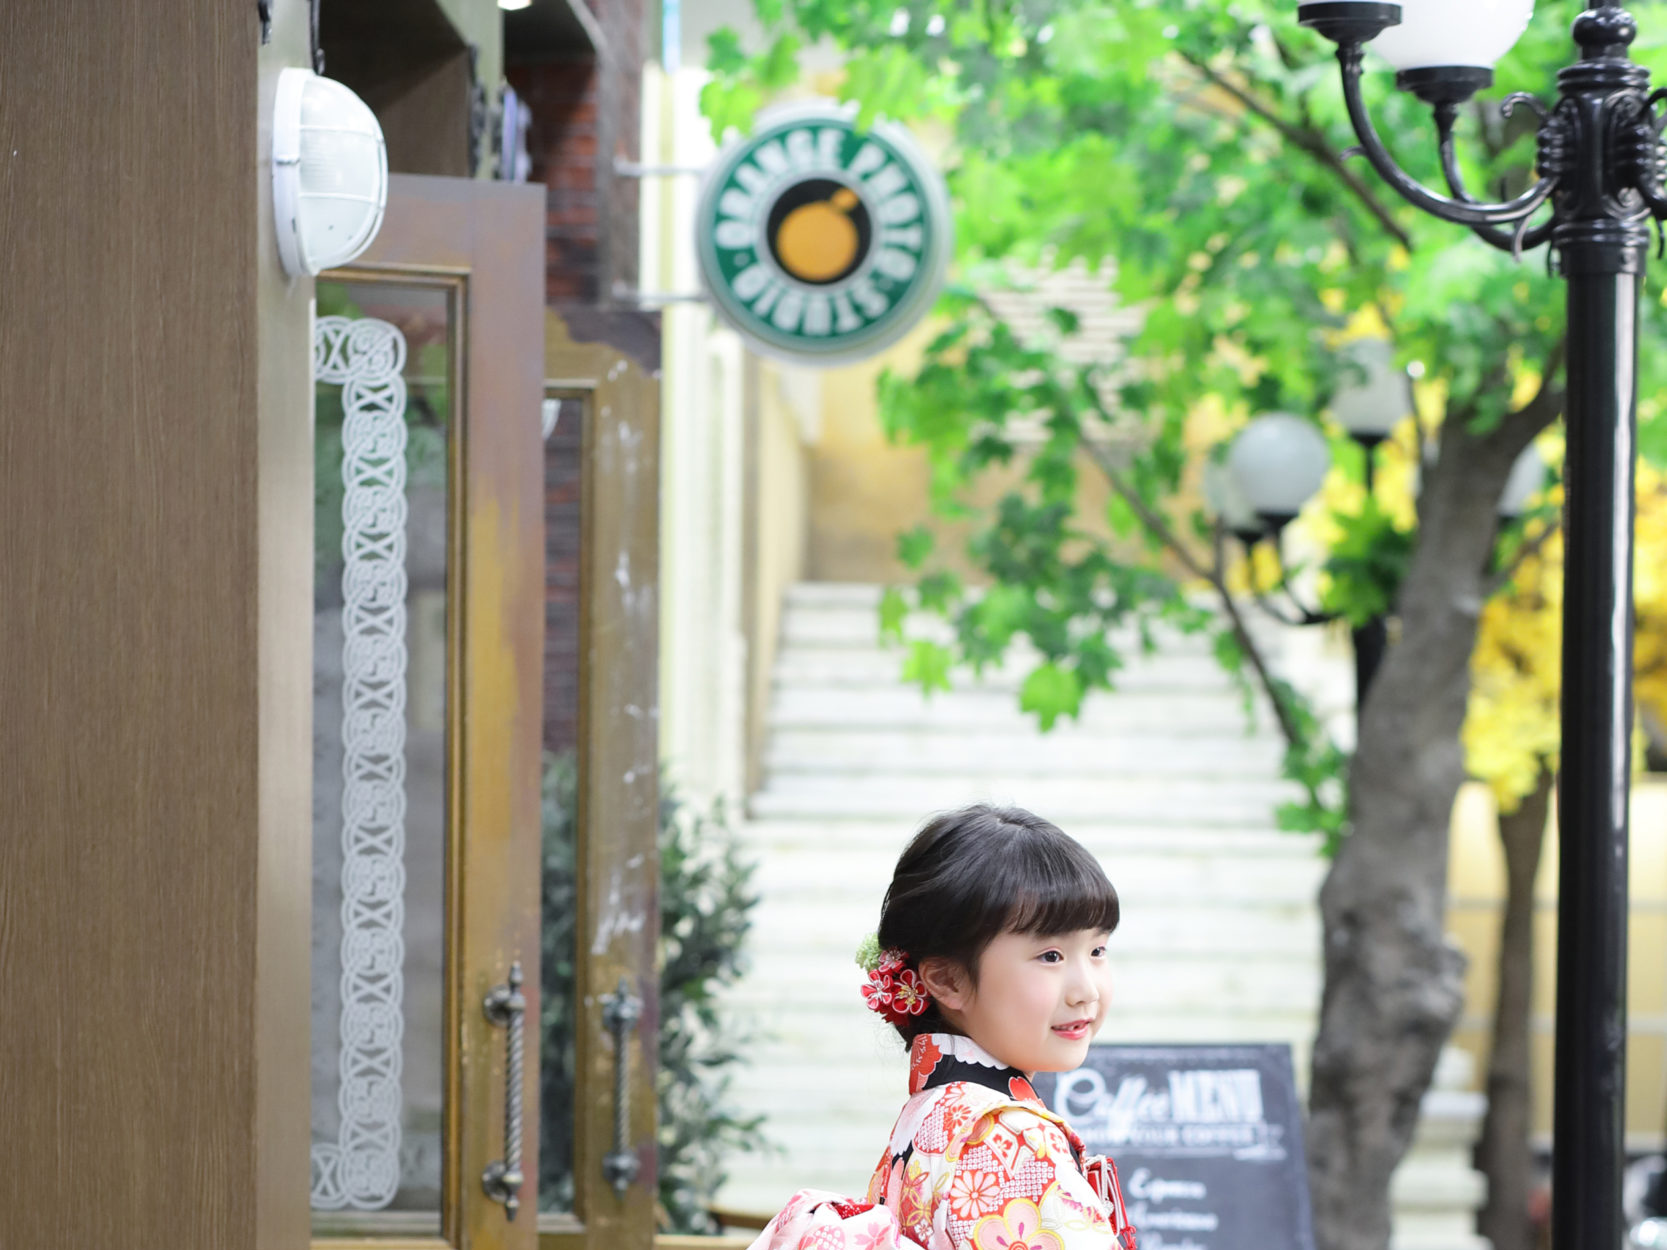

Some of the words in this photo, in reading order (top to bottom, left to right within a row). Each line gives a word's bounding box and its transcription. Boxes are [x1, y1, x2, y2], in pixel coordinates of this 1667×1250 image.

[715, 127, 845, 249] ORANGE
[849, 142, 923, 281] PHOTO
[731, 263, 889, 336] STUDIO
[1054, 1068, 1169, 1141] Coffee
[1168, 1069, 1263, 1124] MENU
